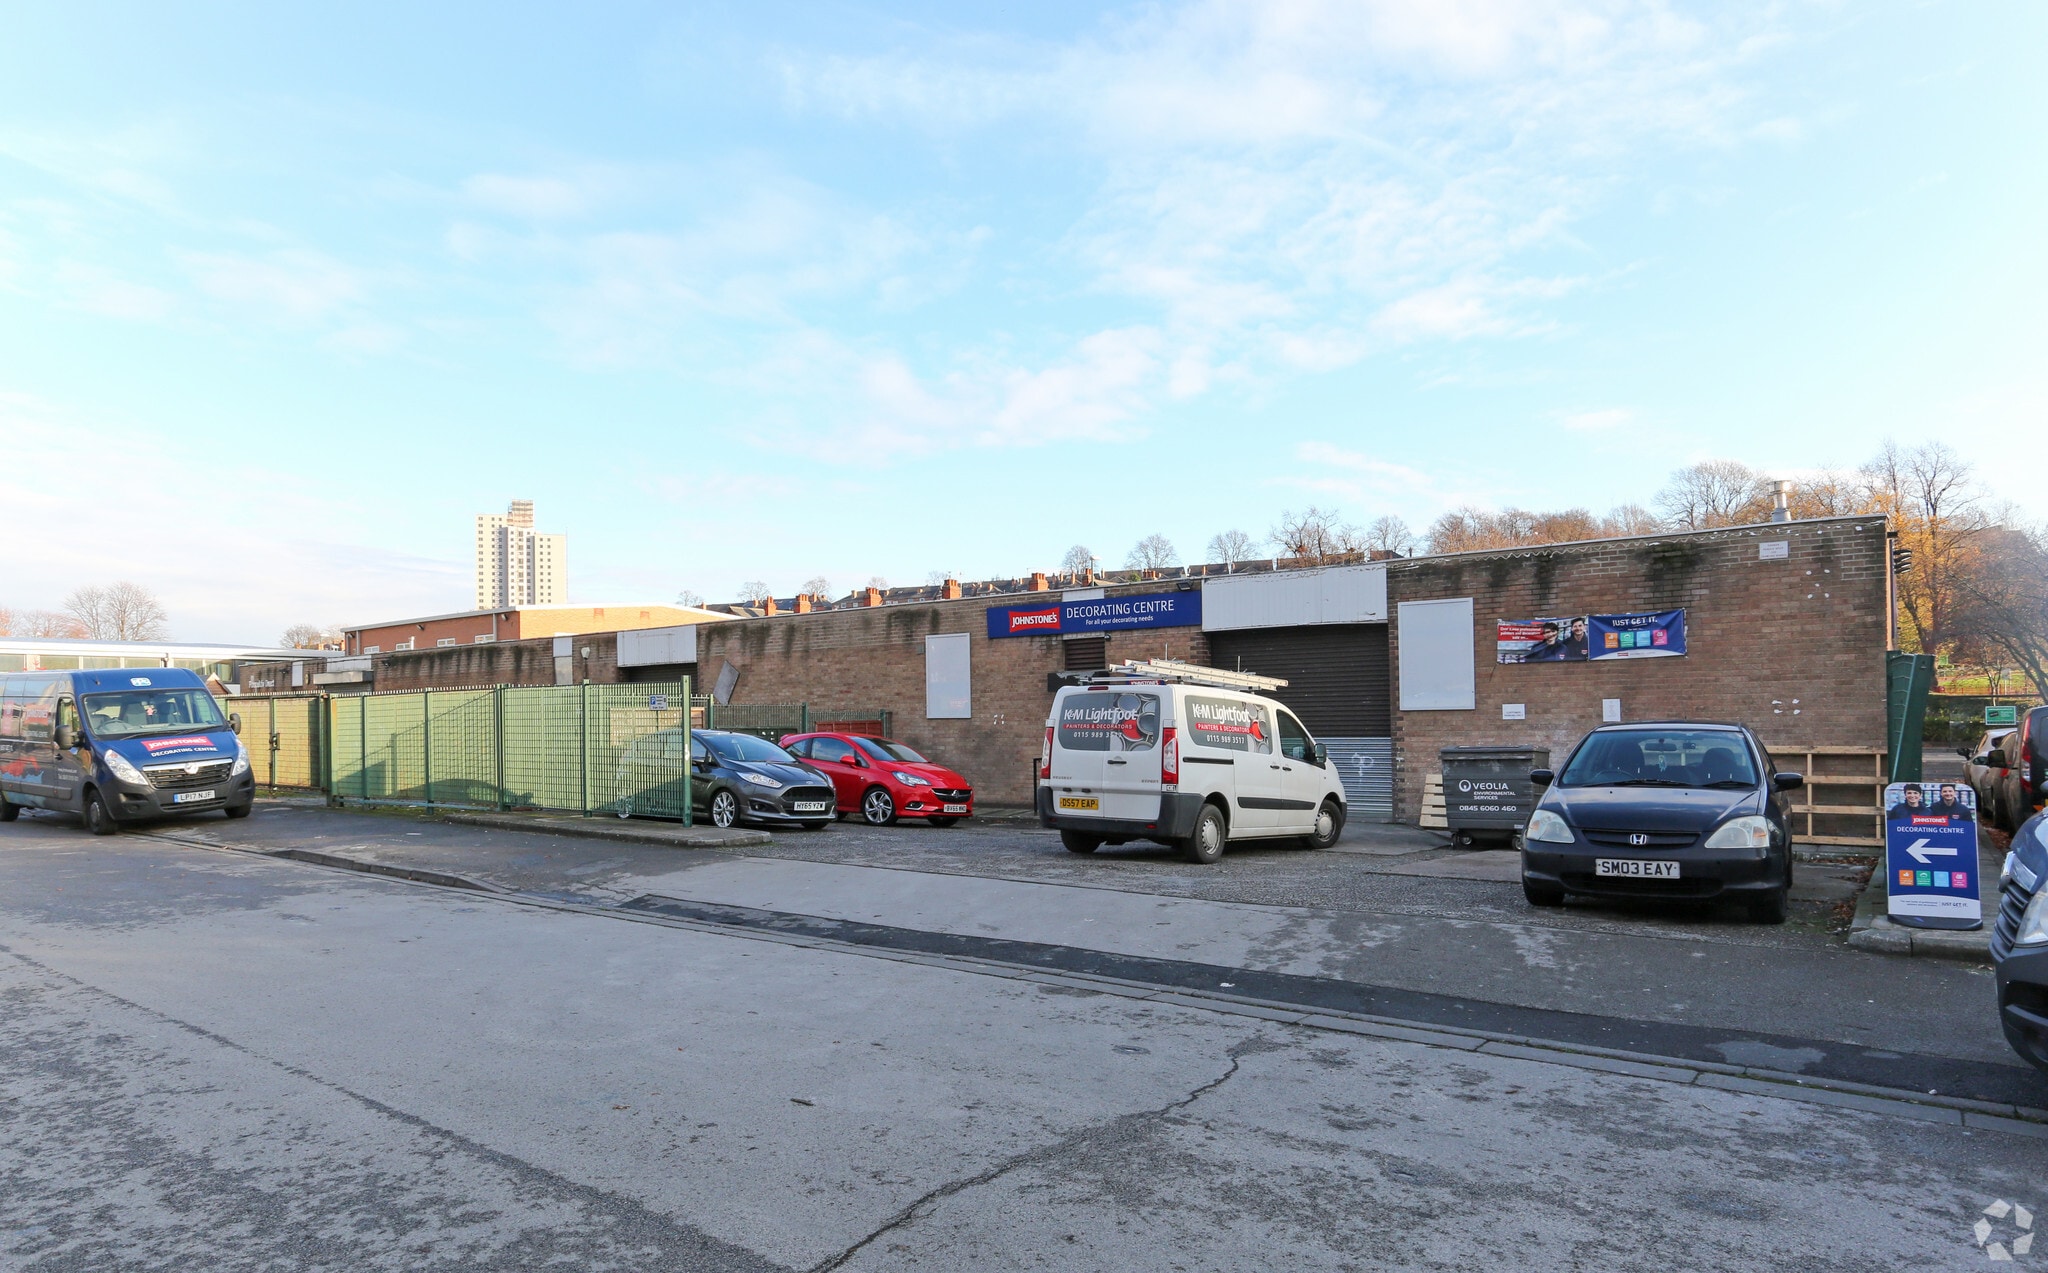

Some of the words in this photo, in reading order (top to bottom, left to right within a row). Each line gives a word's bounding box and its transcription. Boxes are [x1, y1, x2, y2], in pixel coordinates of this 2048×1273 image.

[1066, 602, 1130, 619] DECORATING
[1133, 600, 1174, 613] CENTRE
[1012, 612, 1058, 627] JOHNSTONE'S
[1612, 618, 1630, 626] JUST
[1631, 617, 1647, 625] GET
[1064, 709, 1084, 720] K&M
[1085, 708, 1139, 723] Lightfoot
[1192, 704, 1211, 719] K&M
[1211, 704, 1250, 725] Lightfoot
[148, 738, 207, 748] JOHNSTONE'S
[150, 748, 193, 757] DECORATING
[1062, 799, 1080, 807] DS57
[1081, 800, 1095, 808] EAP
[1602, 861, 1640, 874] SM03
[1644, 862, 1673, 876] EAY
